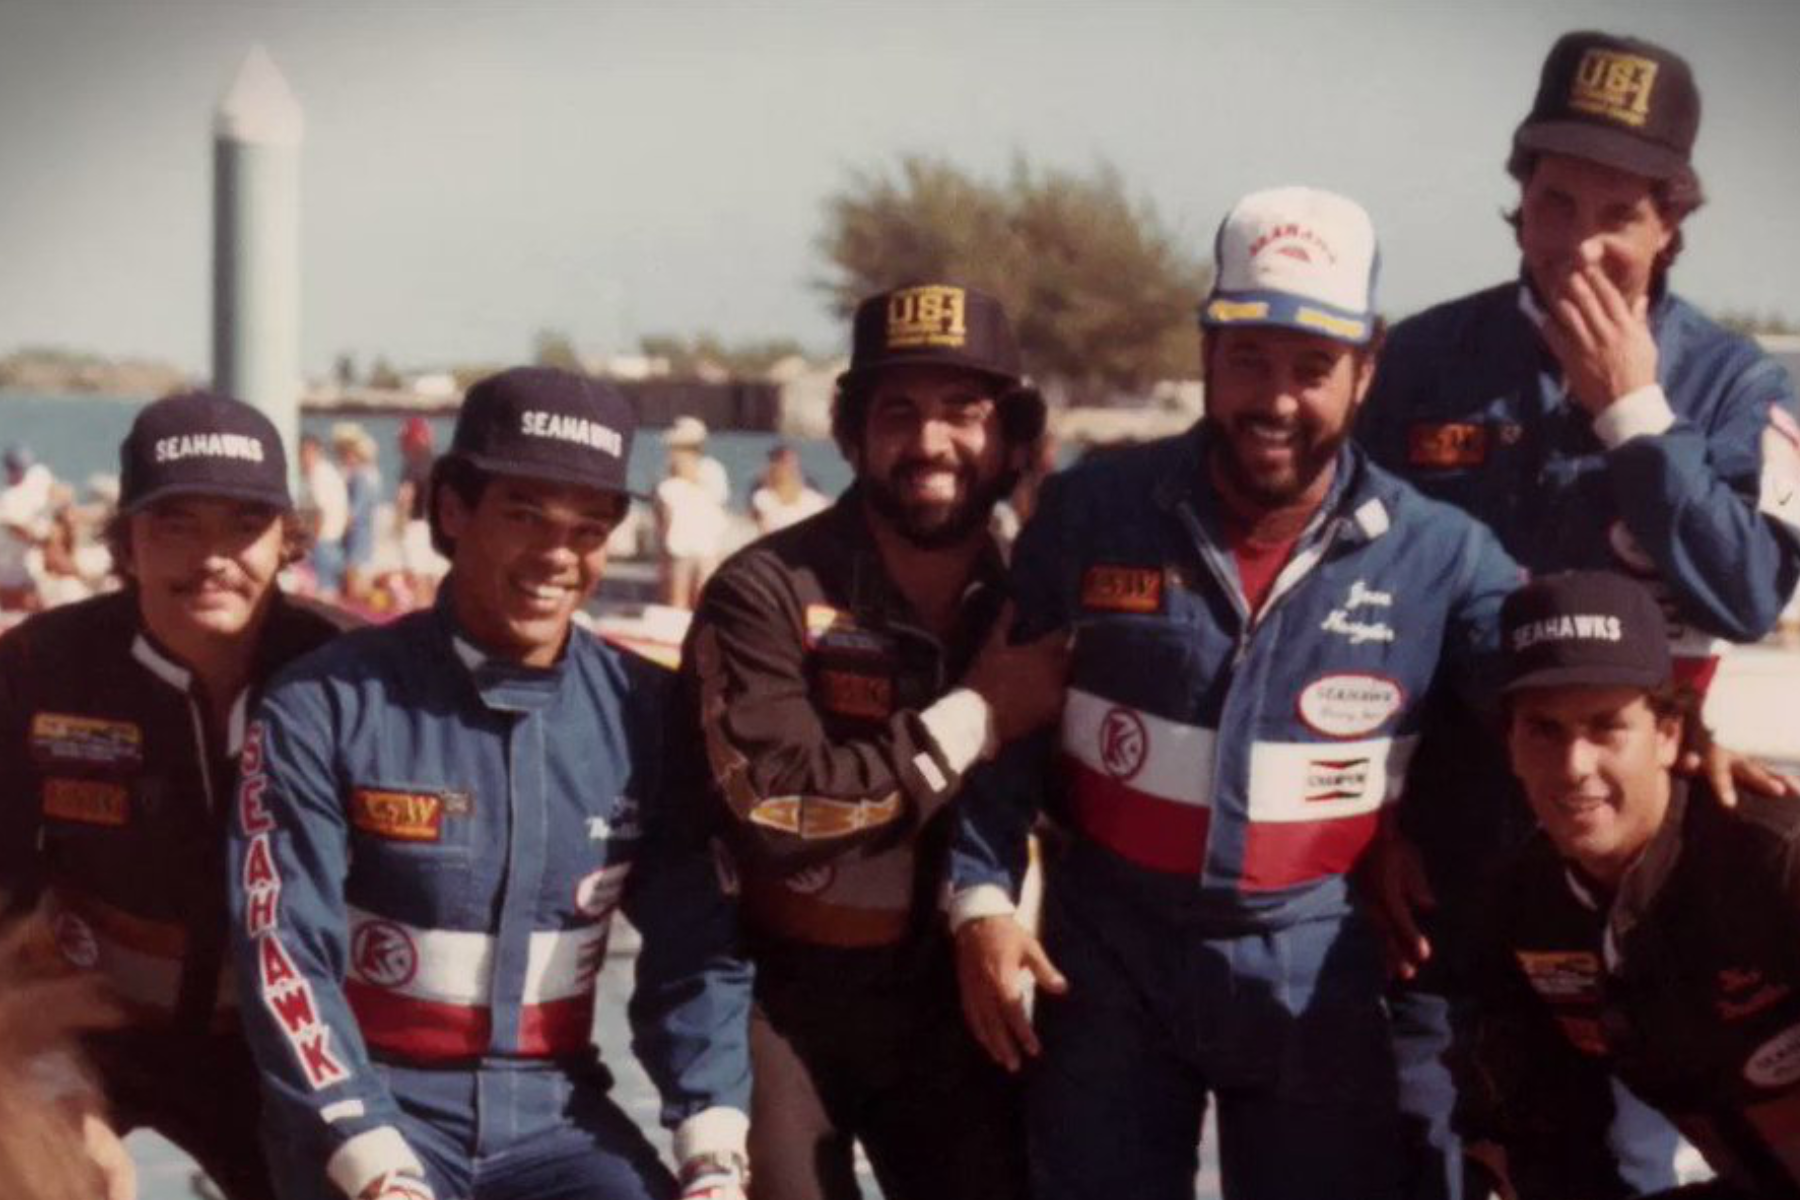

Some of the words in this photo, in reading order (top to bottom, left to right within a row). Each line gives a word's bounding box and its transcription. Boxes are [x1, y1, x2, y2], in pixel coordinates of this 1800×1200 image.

[156, 433, 264, 462] SEAHAWKS
[521, 410, 622, 458] SEAHAWKS
[1514, 614, 1622, 651] SEAHAWKS
[240, 722, 347, 1089] SEAHAWK
